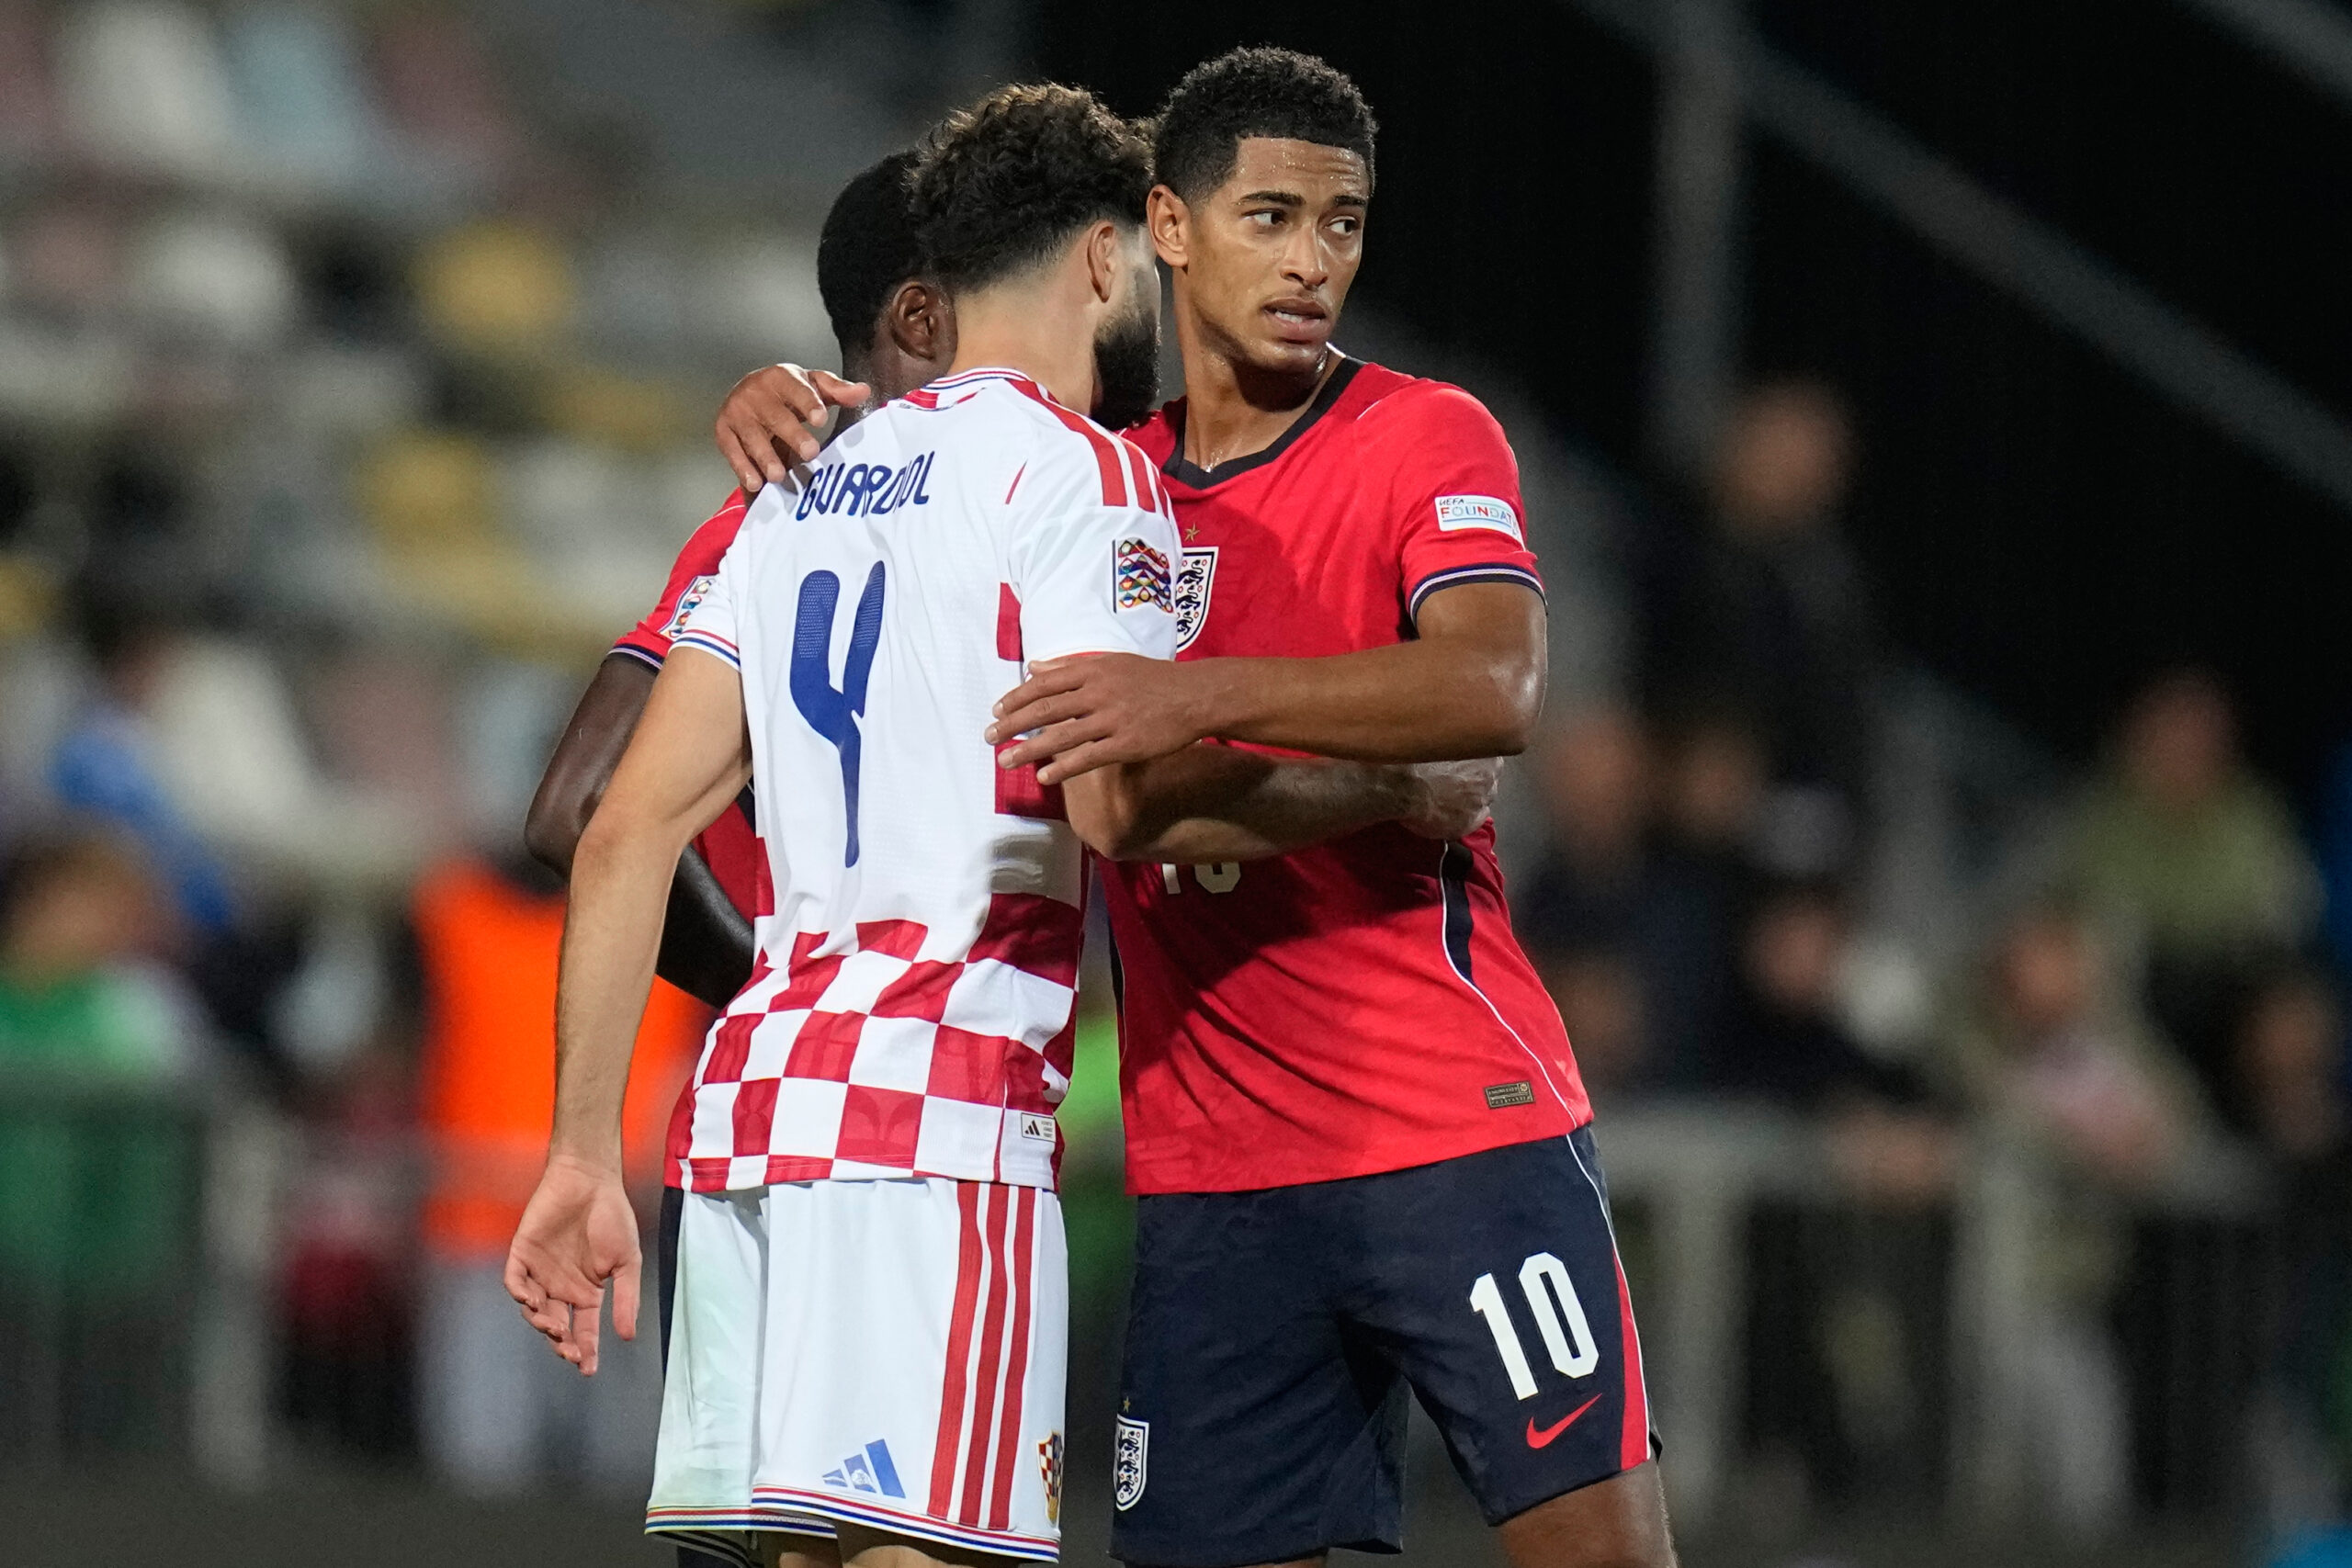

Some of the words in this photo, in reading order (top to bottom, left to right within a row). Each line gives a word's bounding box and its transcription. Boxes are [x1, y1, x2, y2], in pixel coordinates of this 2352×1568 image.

[1439, 497, 1464, 506] UEFA
[1441, 505, 1516, 526] FOUNDAT
[789, 559, 886, 868] 4
[1469, 1251, 1600, 1401] 10
